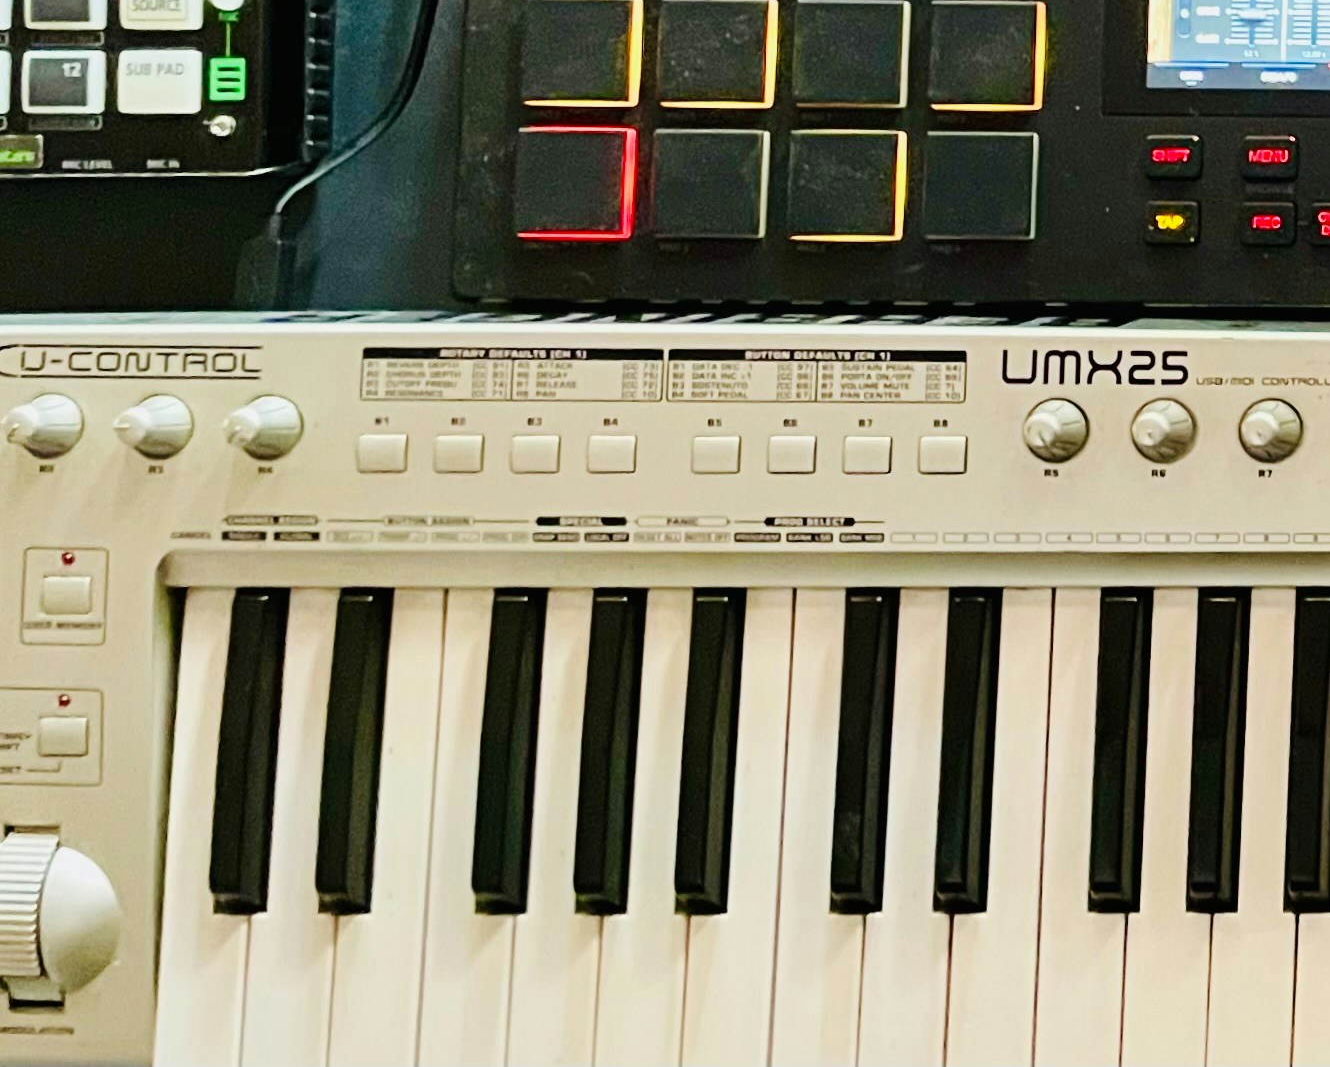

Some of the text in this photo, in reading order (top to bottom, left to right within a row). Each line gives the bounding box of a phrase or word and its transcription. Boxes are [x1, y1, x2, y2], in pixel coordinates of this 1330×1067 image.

[62, 62, 82, 78] 12
[125, 63, 184, 76] SUB PAD
[1151, 147, 1191, 162] SHIFT
[1248, 148, 1289, 163] MENU
[1155, 215, 1184, 230] TAP
[1251, 215, 1282, 230] REC
[20, 350, 263, 374] U-CONTROL
[1001, 348, 1190, 386] UMX25
